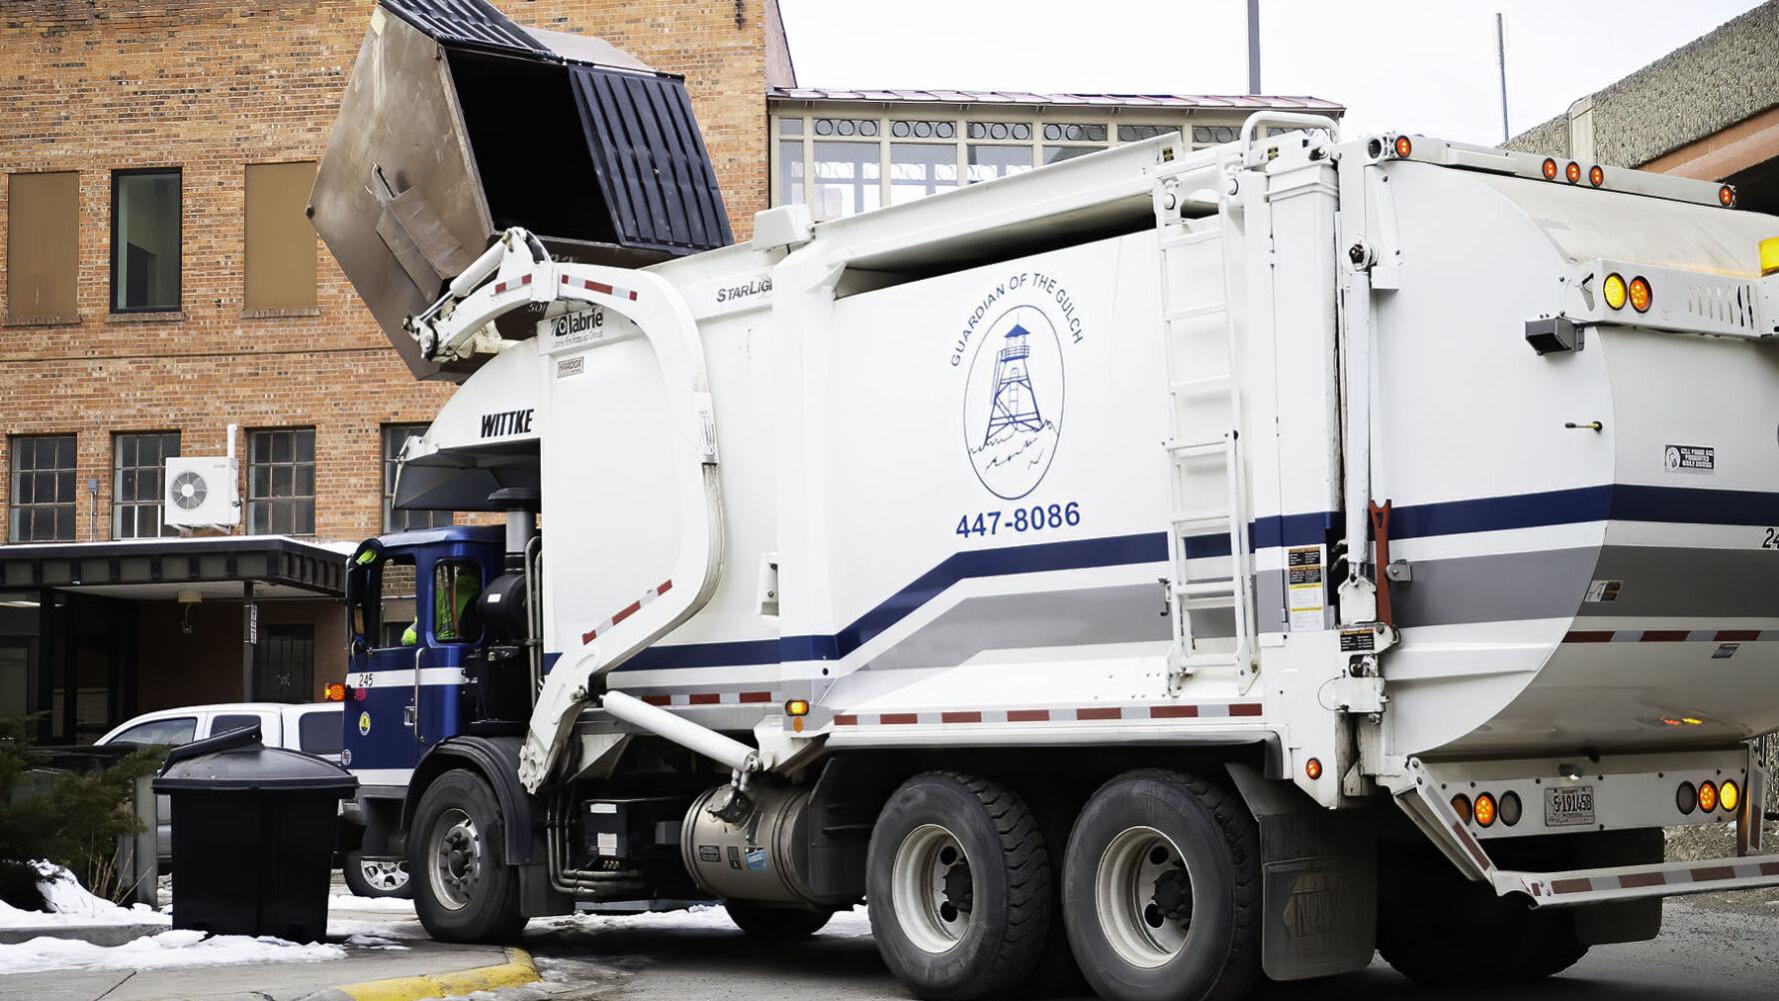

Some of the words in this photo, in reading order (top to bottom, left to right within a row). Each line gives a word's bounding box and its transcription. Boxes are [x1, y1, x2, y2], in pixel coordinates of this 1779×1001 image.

[716, 279, 773, 303] STARLIG
[569, 307, 604, 334] labrie
[950, 284, 1005, 367] GUARDIAN
[1009, 273, 1028, 290] OF
[1032, 273, 1057, 294] THE
[1055, 289, 1084, 344] GULCH
[480, 408, 535, 438] WITTKE
[956, 501, 1081, 538] 447-8086
[359, 673, 374, 687] 245
